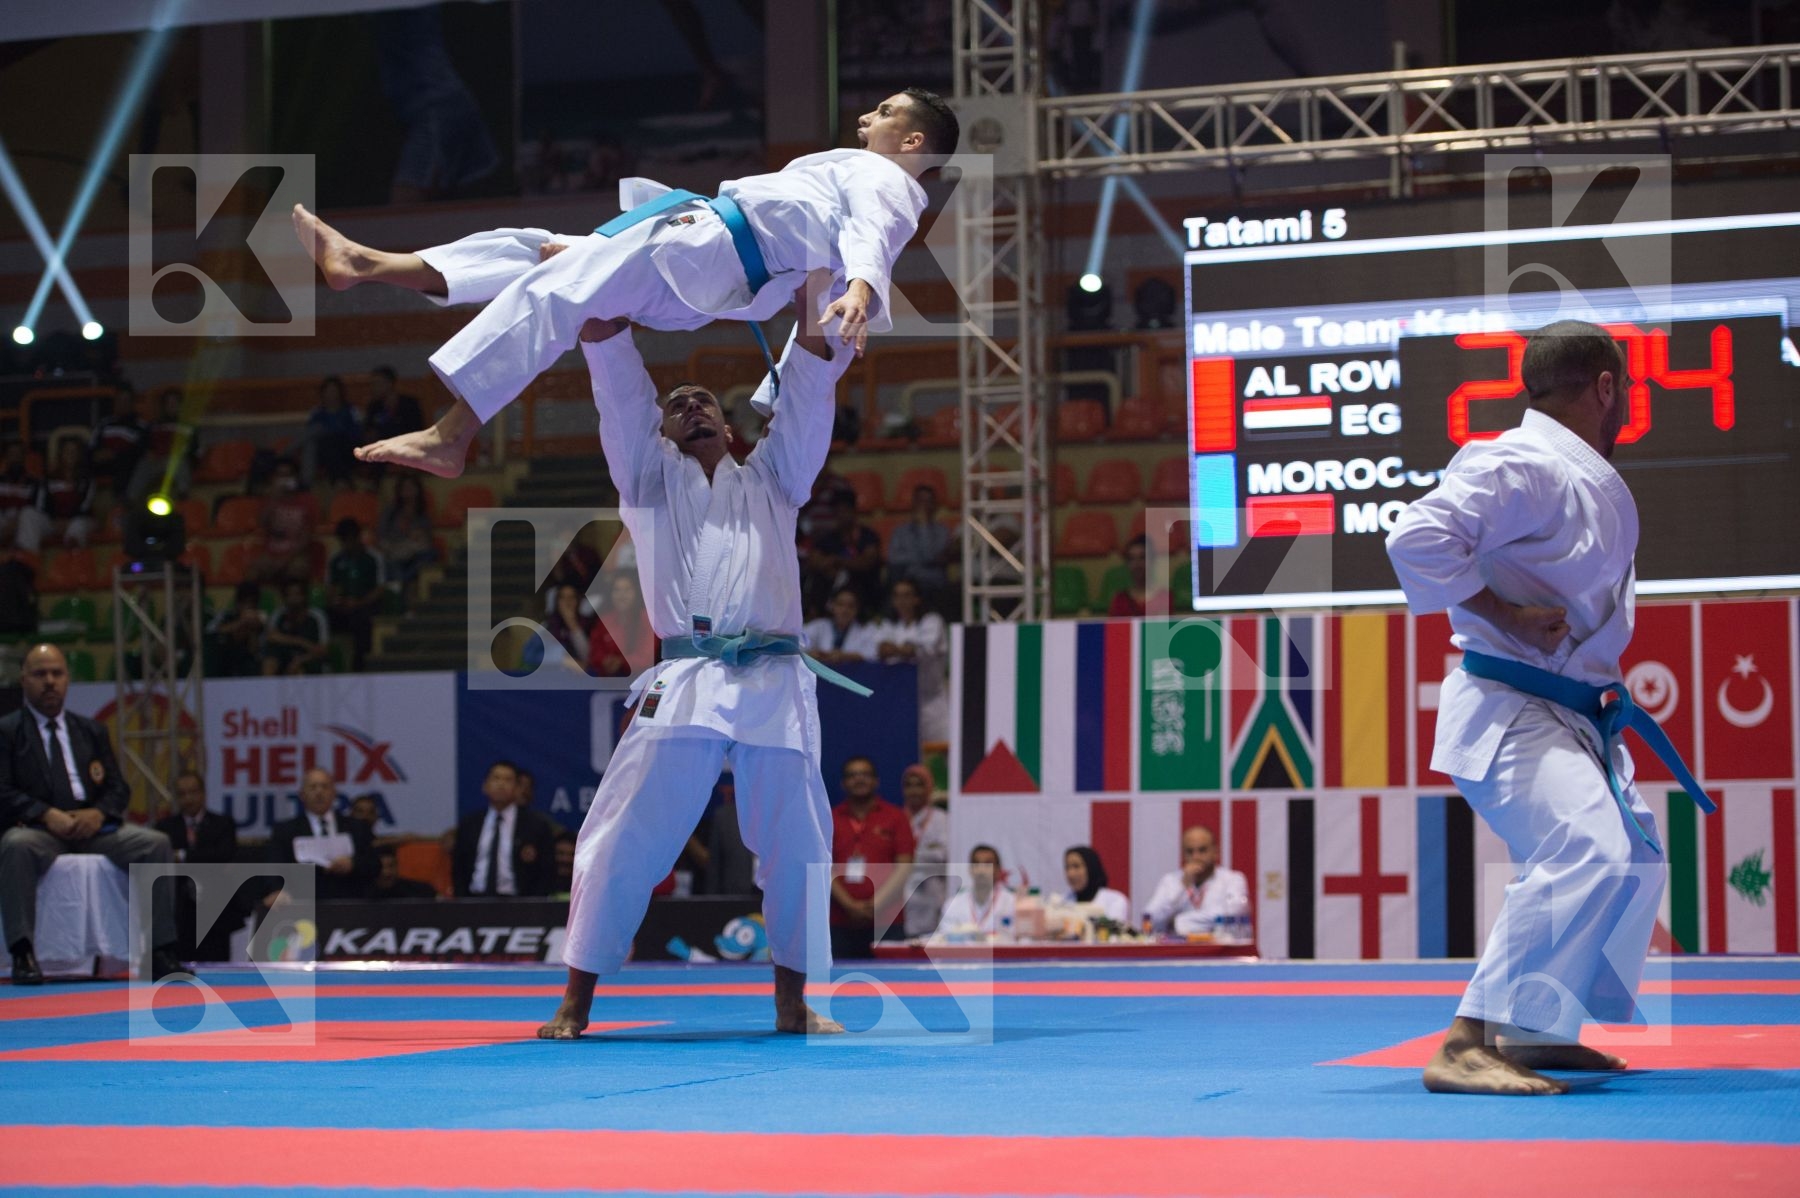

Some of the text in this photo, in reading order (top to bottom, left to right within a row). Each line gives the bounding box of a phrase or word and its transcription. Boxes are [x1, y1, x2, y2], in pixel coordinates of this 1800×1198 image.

[1183, 208, 1347, 249] Tatami 5
[1193, 320, 1285, 354] Male
[1293, 317, 1400, 347] Team
[1243, 365, 1301, 398] AL
[1340, 402, 1400, 436] EG
[1247, 456, 1445, 495] MOROC
[222, 705, 298, 740] Shell
[220, 741, 400, 787] HELIX
